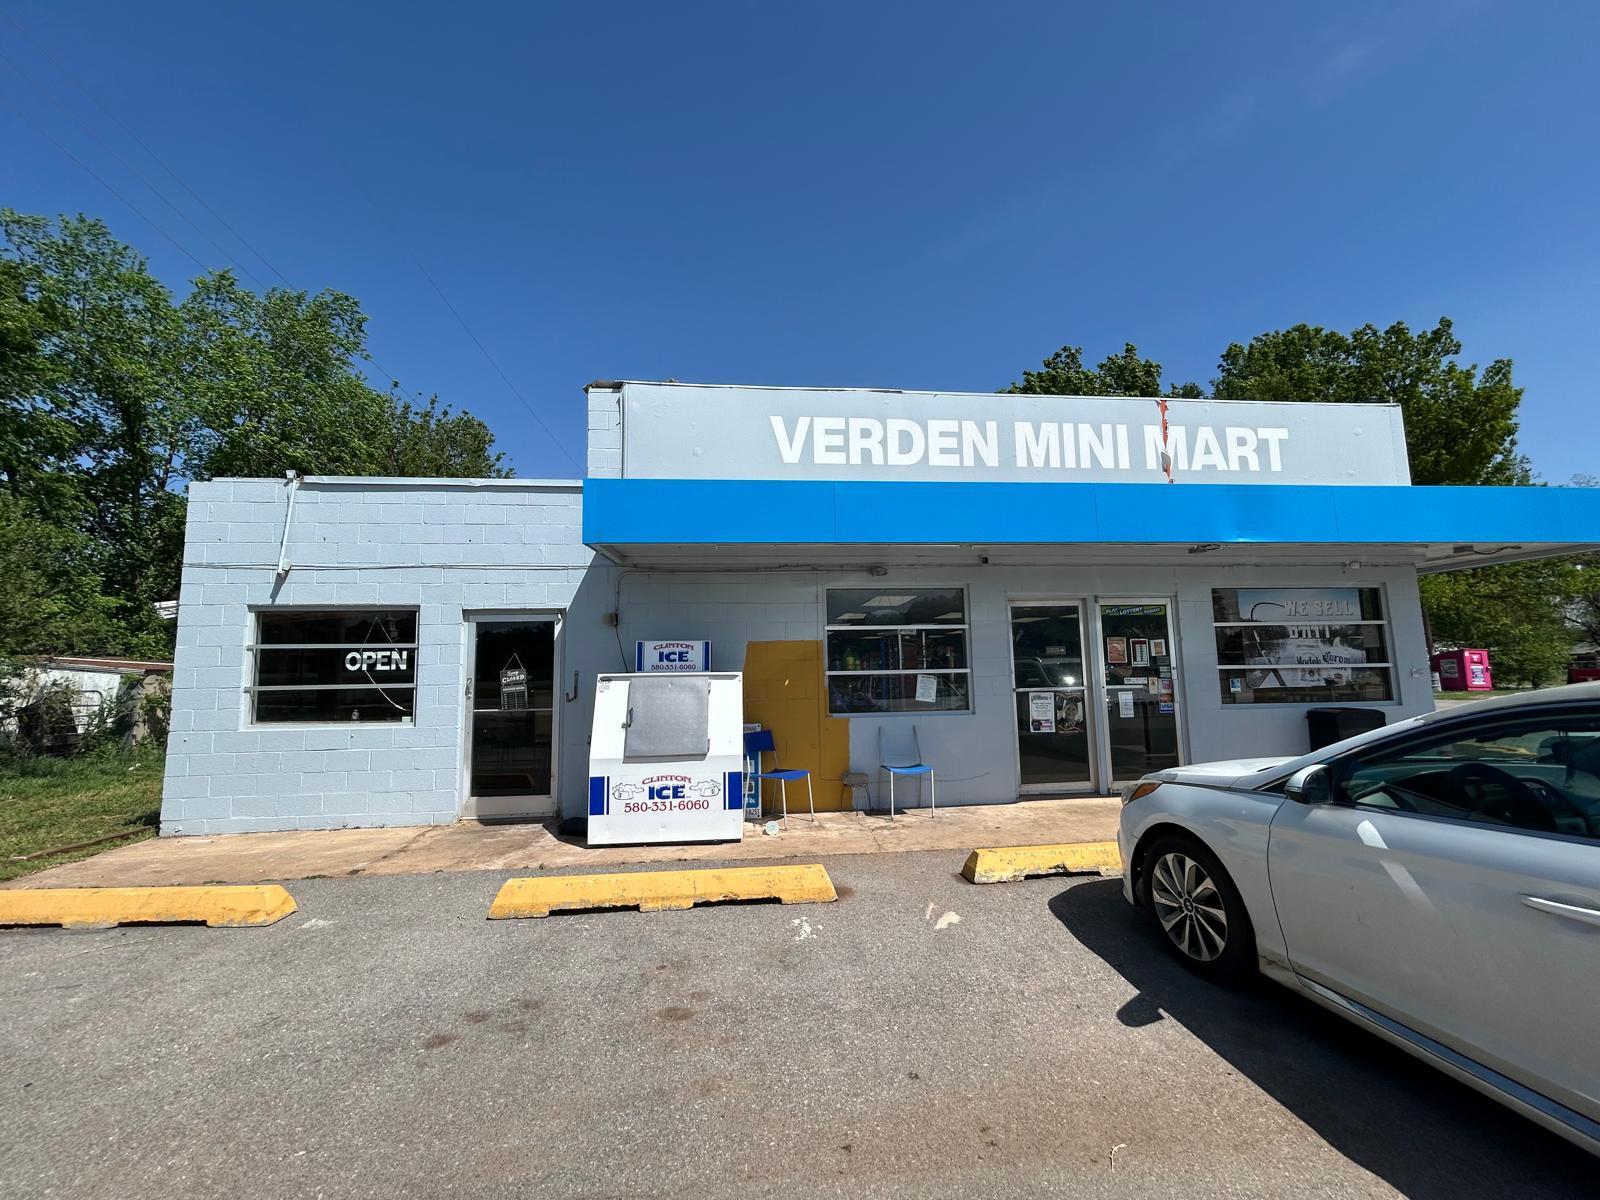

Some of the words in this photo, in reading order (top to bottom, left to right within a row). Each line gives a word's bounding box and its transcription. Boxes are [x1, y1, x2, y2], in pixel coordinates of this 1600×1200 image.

[769, 415, 999, 468] VERDEN
[1014, 421, 1130, 470] MINI
[1143, 423, 1289, 472] MART
[1119, 606, 1143, 615] LOTTERY
[1285, 599, 1309, 616] WE
[1315, 599, 1353, 616] SELL
[345, 651, 406, 671] OPEN
[658, 651, 689, 663] ICE
[642, 775, 692, 785] CLINTON
[648, 784, 686, 800] ICE
[624, 799, 710, 814] 580-331-6060
